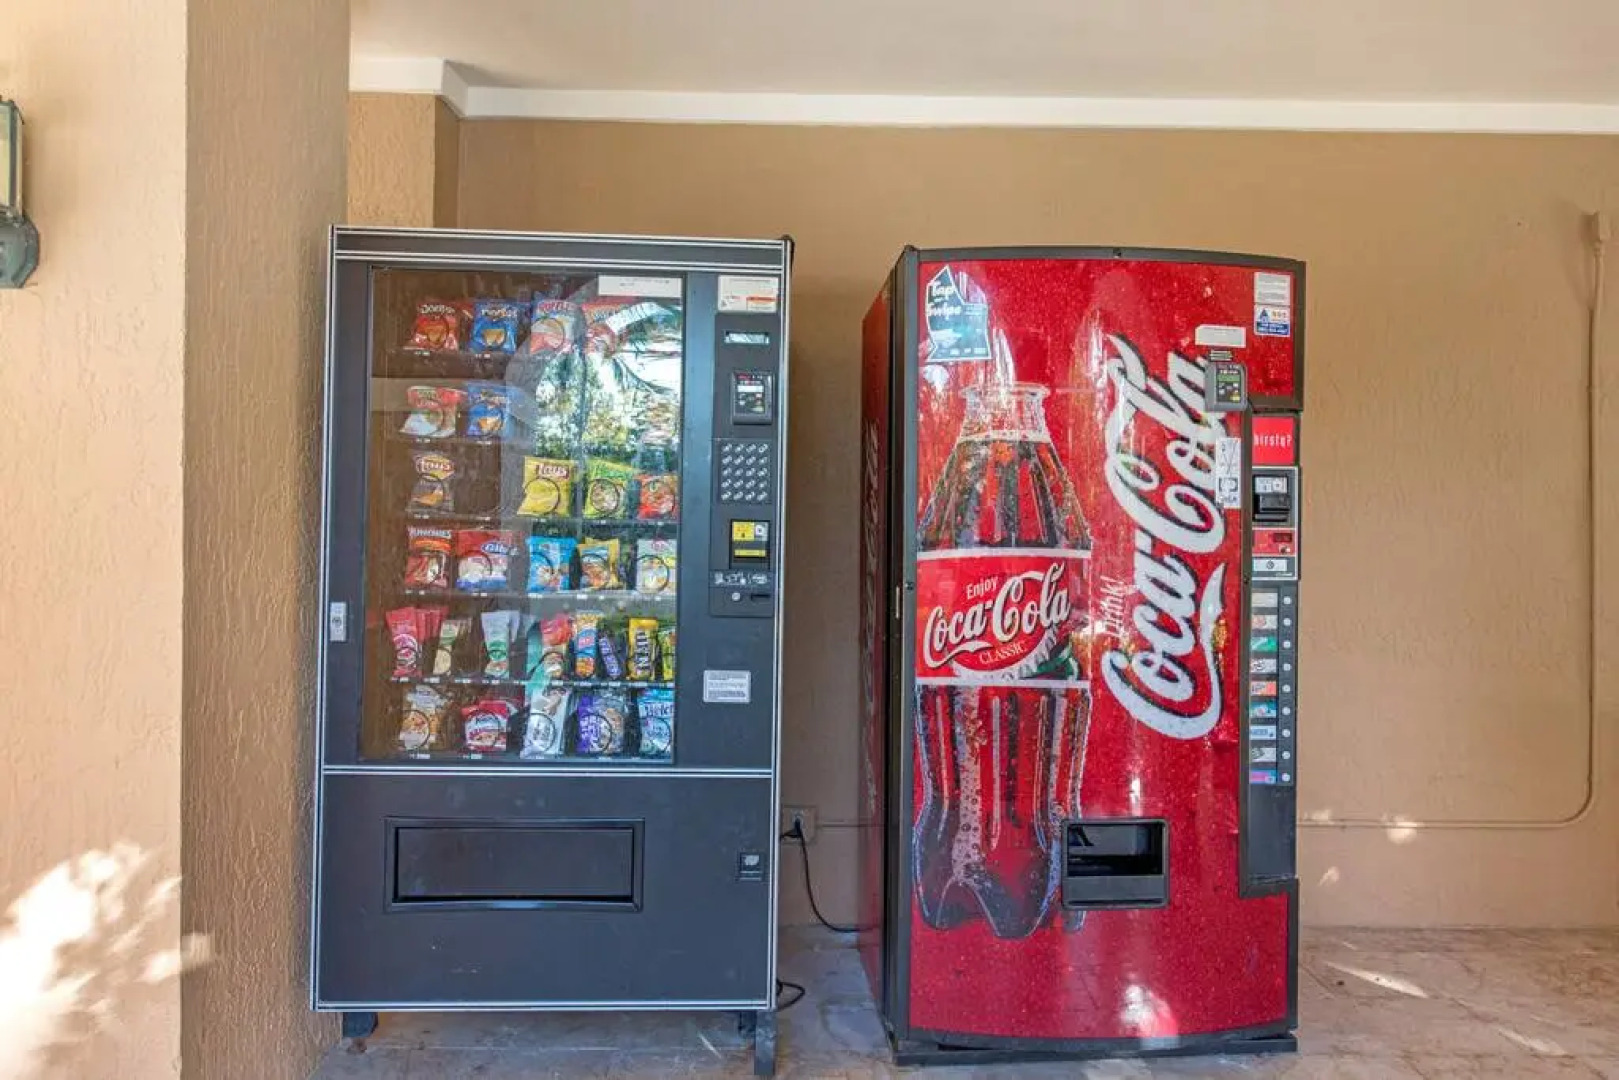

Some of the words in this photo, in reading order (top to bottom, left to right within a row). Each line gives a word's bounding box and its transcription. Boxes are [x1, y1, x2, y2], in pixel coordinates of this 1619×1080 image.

[931, 280, 954, 301] Tap
[927, 302, 962, 320] Swipe
[1101, 334, 1226, 741] Coca-Cola
[966, 576, 999, 601] Enjoy
[922, 562, 1071, 669] Coca-Cola
[978, 640, 1025, 666] CLASSIC
